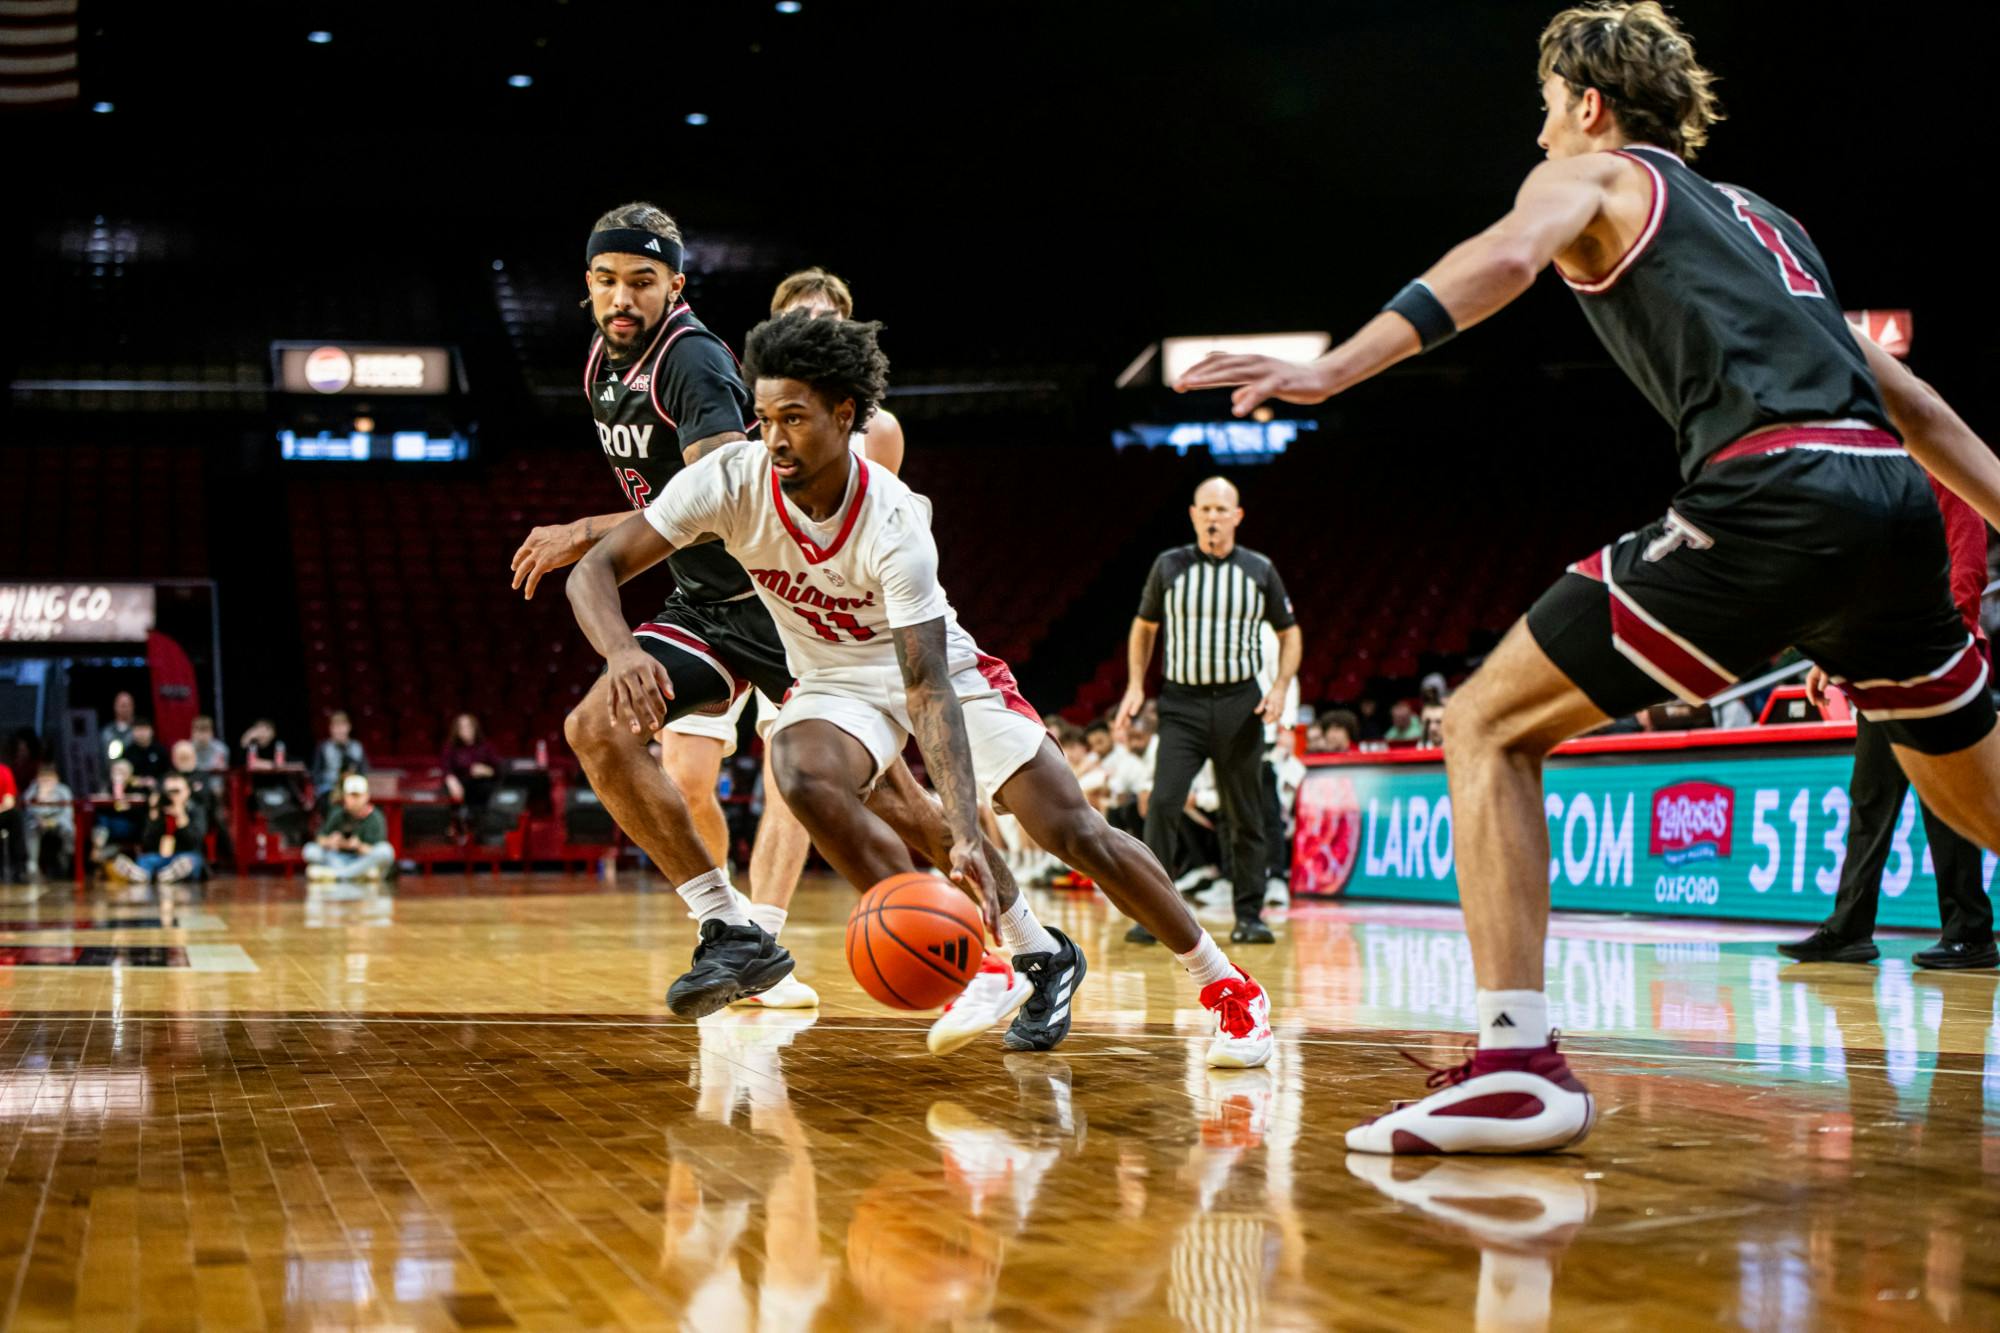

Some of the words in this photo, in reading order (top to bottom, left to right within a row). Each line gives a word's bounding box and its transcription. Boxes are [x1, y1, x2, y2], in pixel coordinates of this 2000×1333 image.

[1712, 183, 1826, 299] 1
[594, 418, 654, 459] ROY
[615, 466, 652, 512] 12
[793, 606, 876, 642] 11
[1655, 875, 1719, 905] OXFORD
